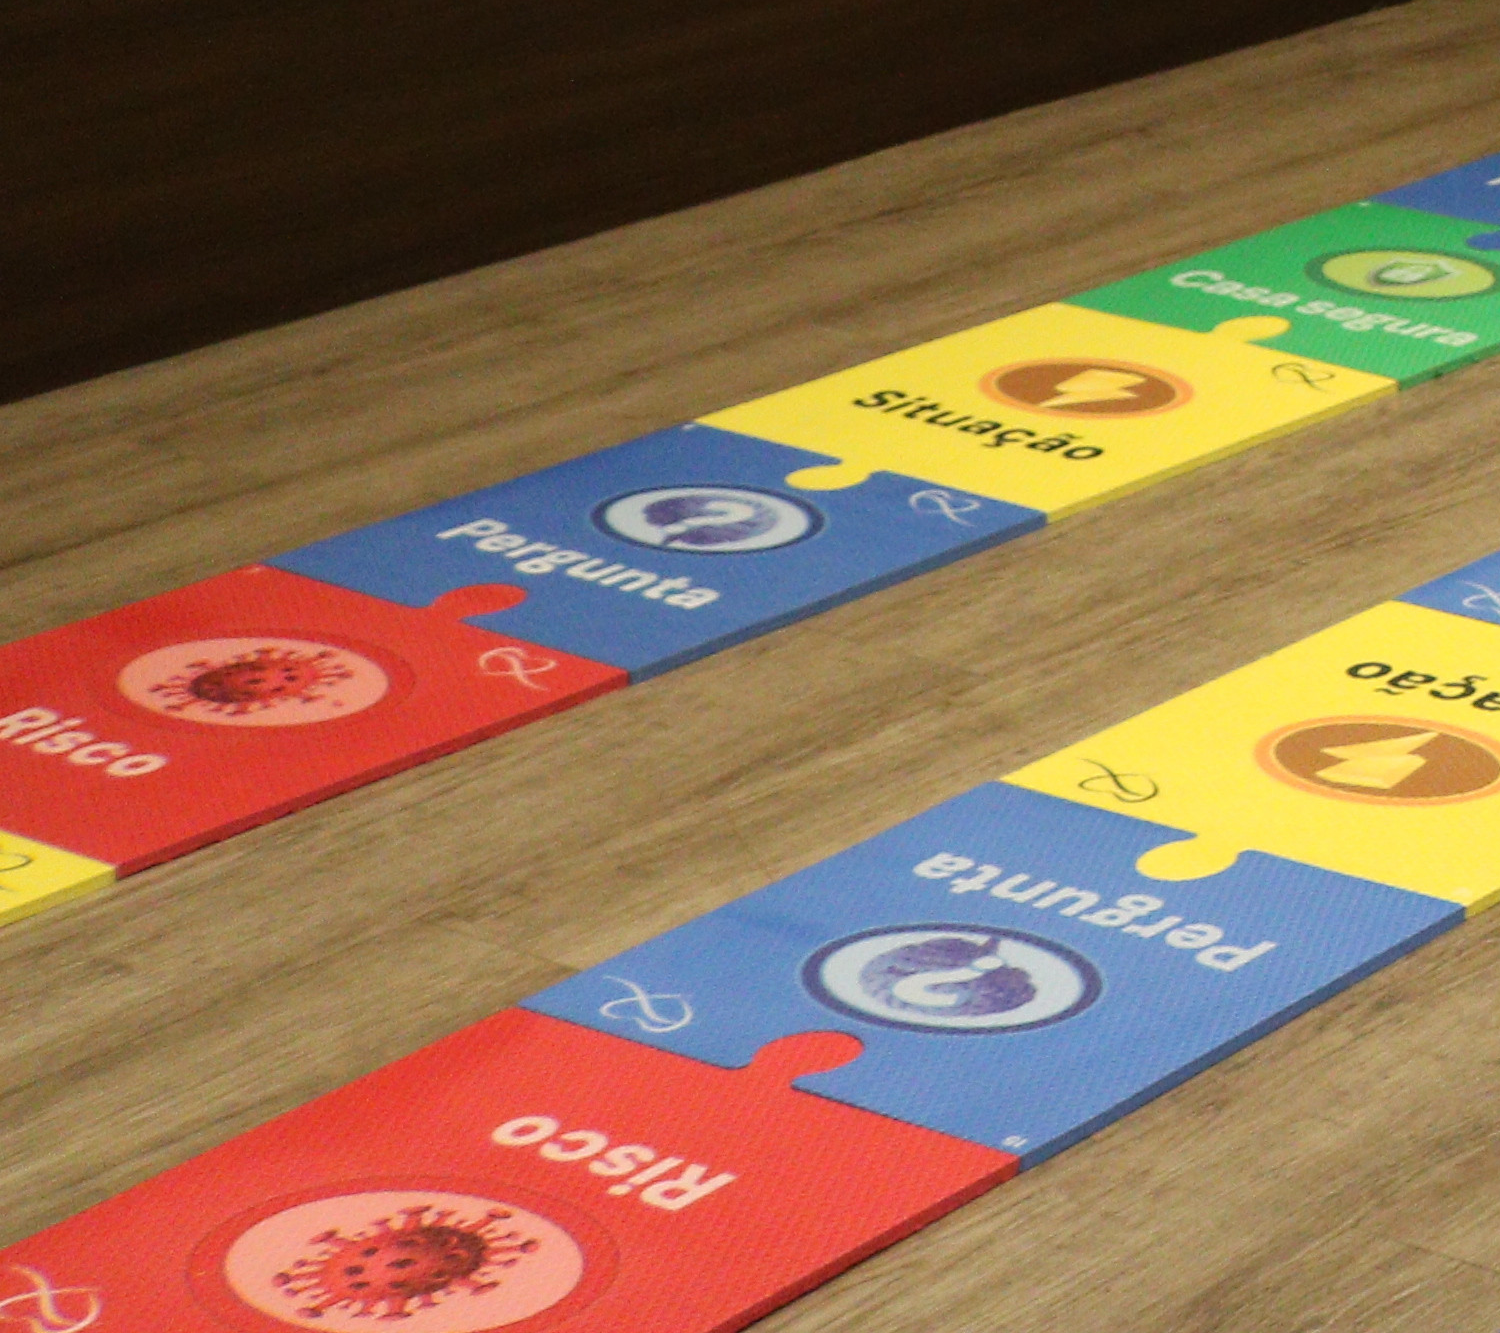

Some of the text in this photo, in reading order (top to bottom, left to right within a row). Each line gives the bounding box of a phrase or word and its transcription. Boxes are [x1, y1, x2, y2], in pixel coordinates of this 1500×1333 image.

[1169, 269, 1480, 349] Casa segura
[851, 386, 1105, 463] Situação
[436, 517, 720, 611] Pergunta
[0, 707, 170, 779] Risco
[912, 852, 1278, 973] Pergunta
[492, 1114, 738, 1213] Risco
